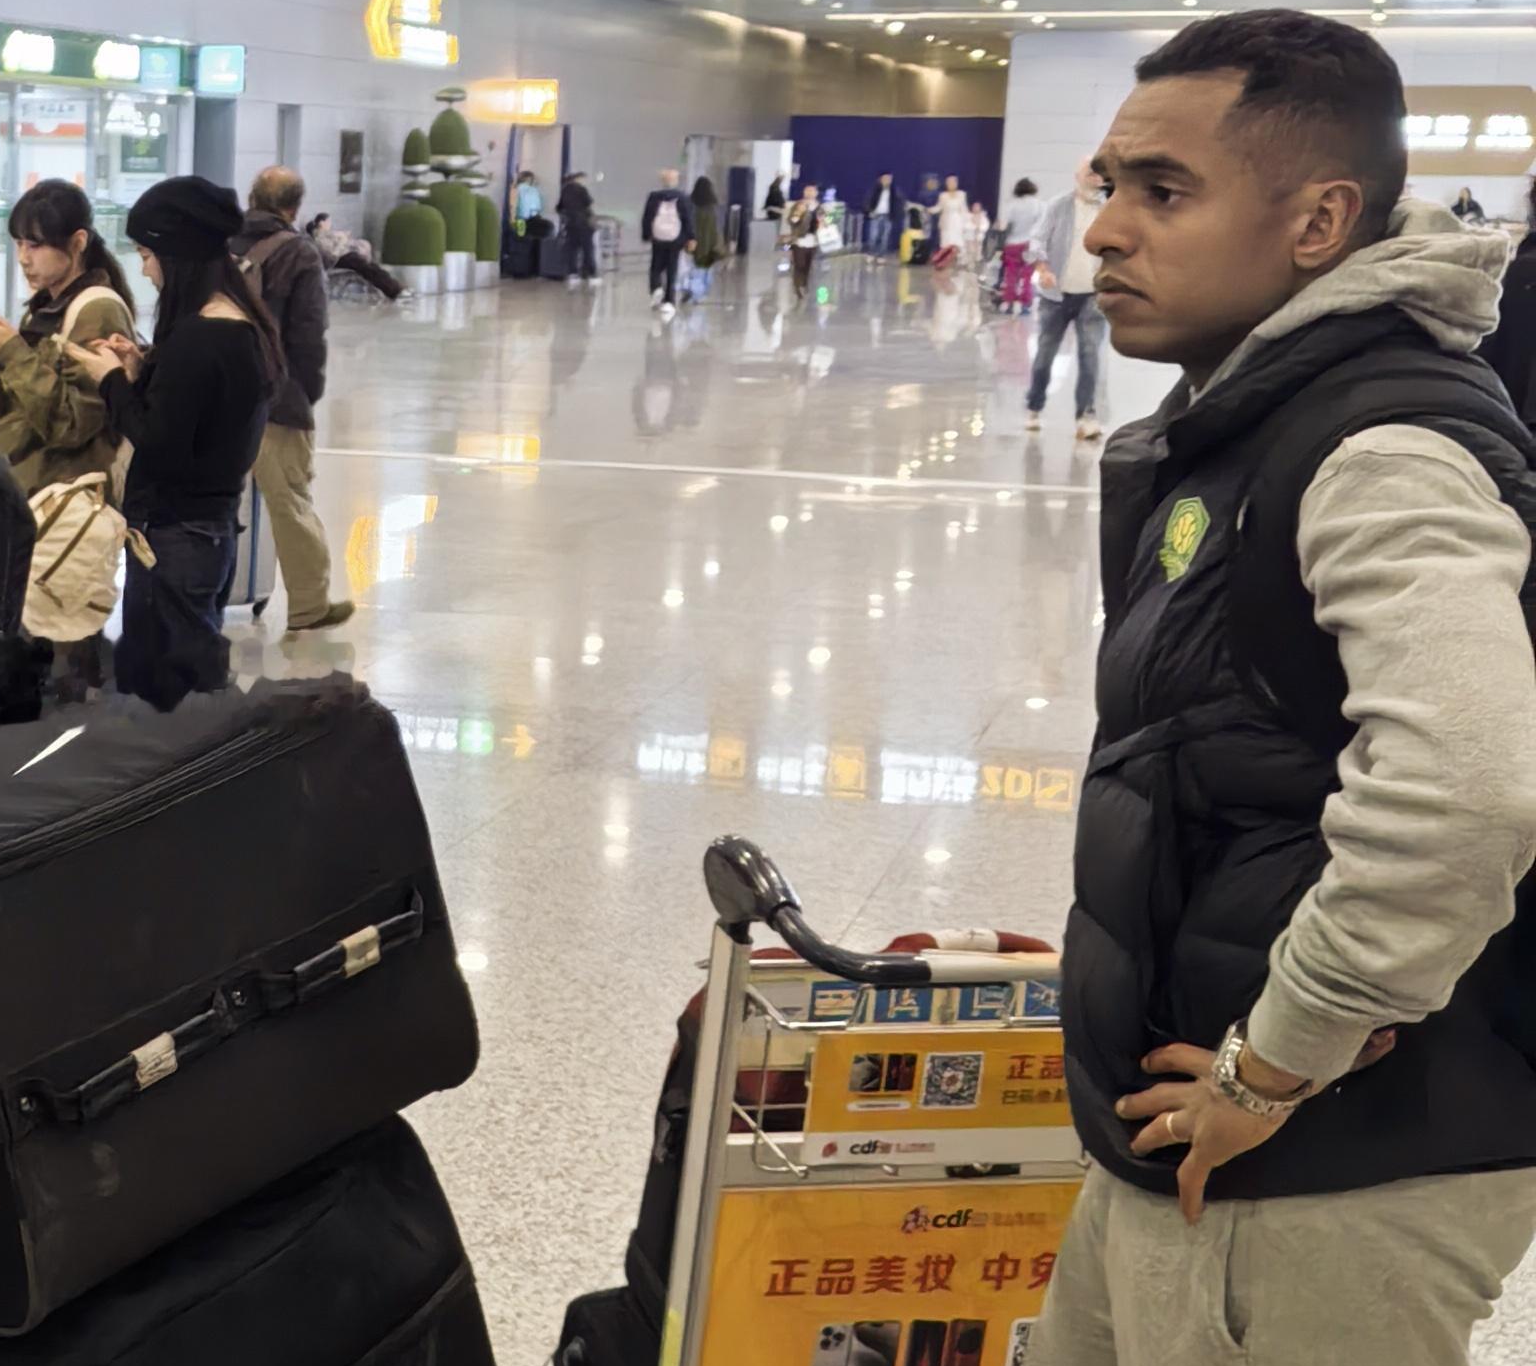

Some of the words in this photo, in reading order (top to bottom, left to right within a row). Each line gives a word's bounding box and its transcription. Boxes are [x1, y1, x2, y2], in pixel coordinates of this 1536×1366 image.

[849, 1140, 880, 1156] cdf
[931, 1208, 973, 1228] cdf
[764, 1253, 958, 1297] 正品美妆
